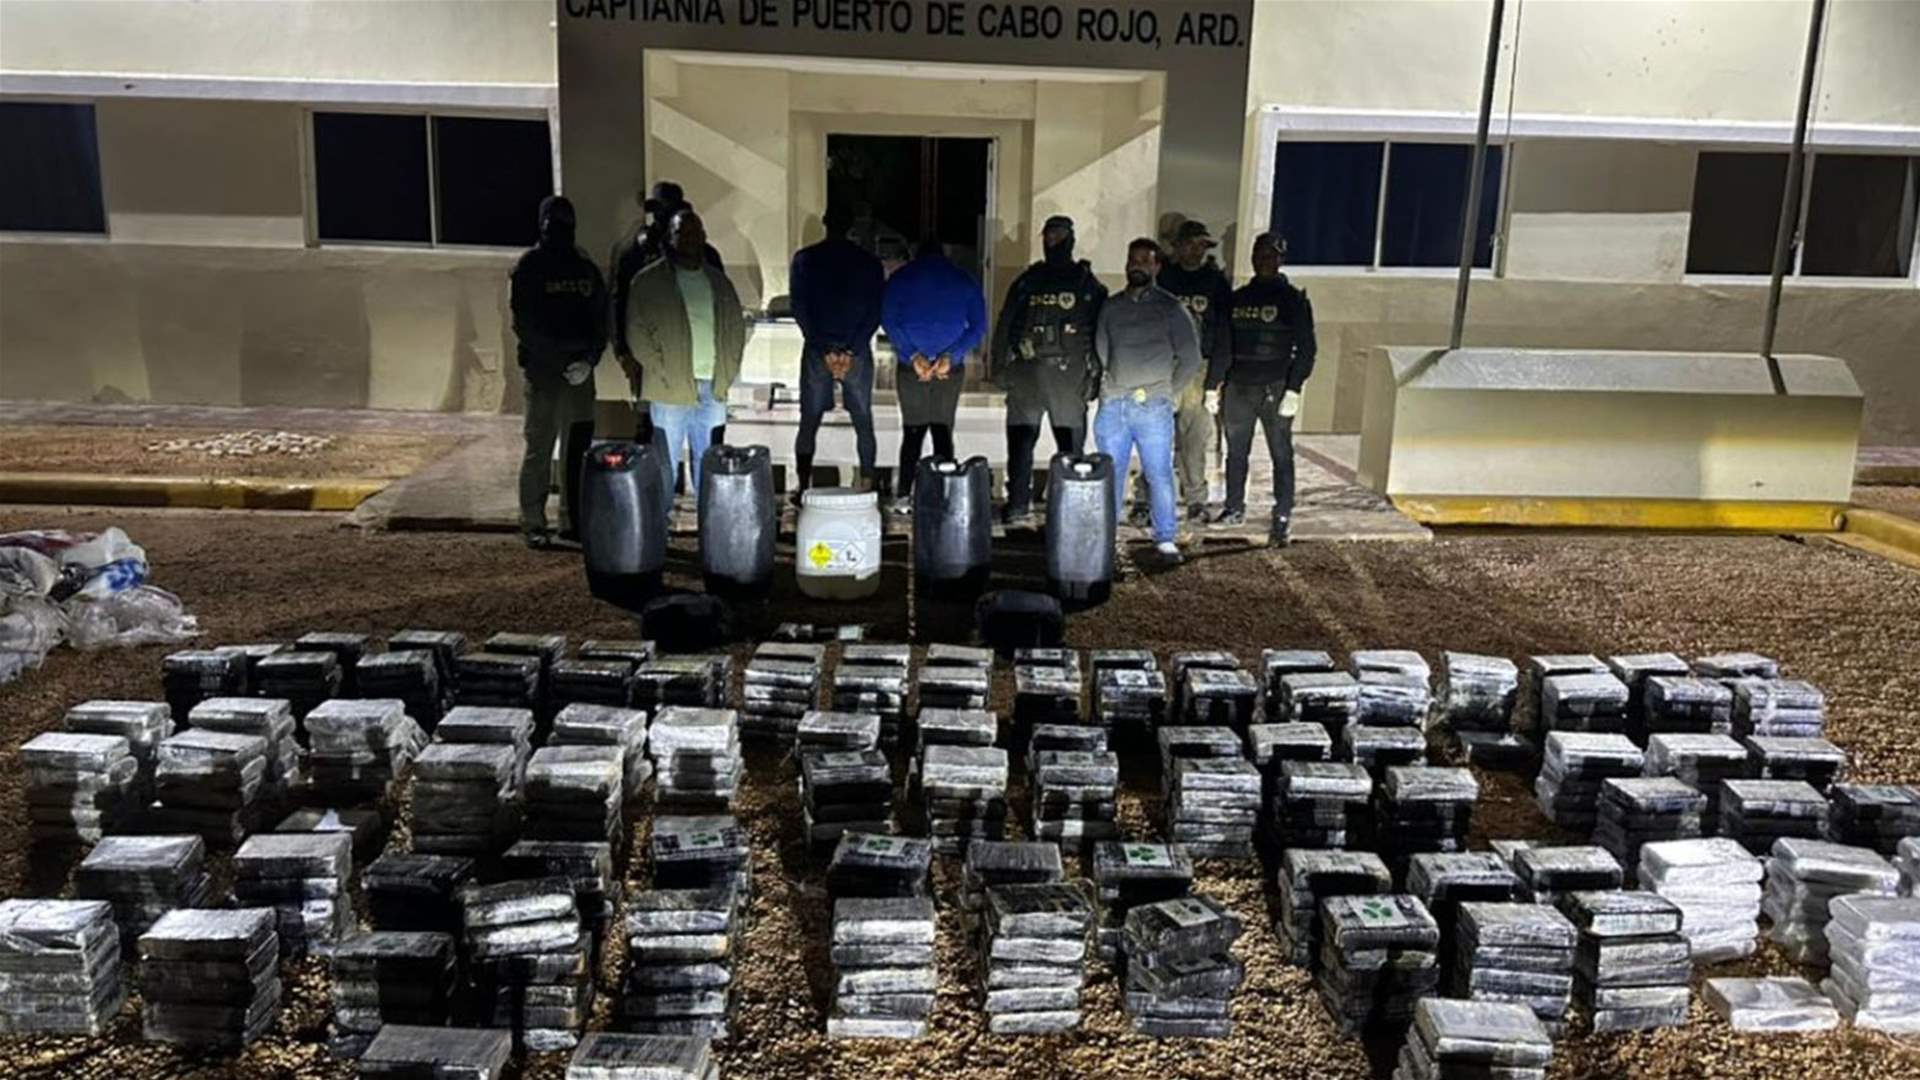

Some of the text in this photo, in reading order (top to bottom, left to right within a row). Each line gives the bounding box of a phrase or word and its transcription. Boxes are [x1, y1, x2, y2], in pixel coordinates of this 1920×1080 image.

[739, 0, 778, 27] DE
[793, 0, 913, 33] PUERTO
[926, 2, 965, 36] DE
[977, 4, 1063, 40] CABO
[1076, 8, 1162, 49] ROJO,
[1174, 12, 1245, 47] ARD.
